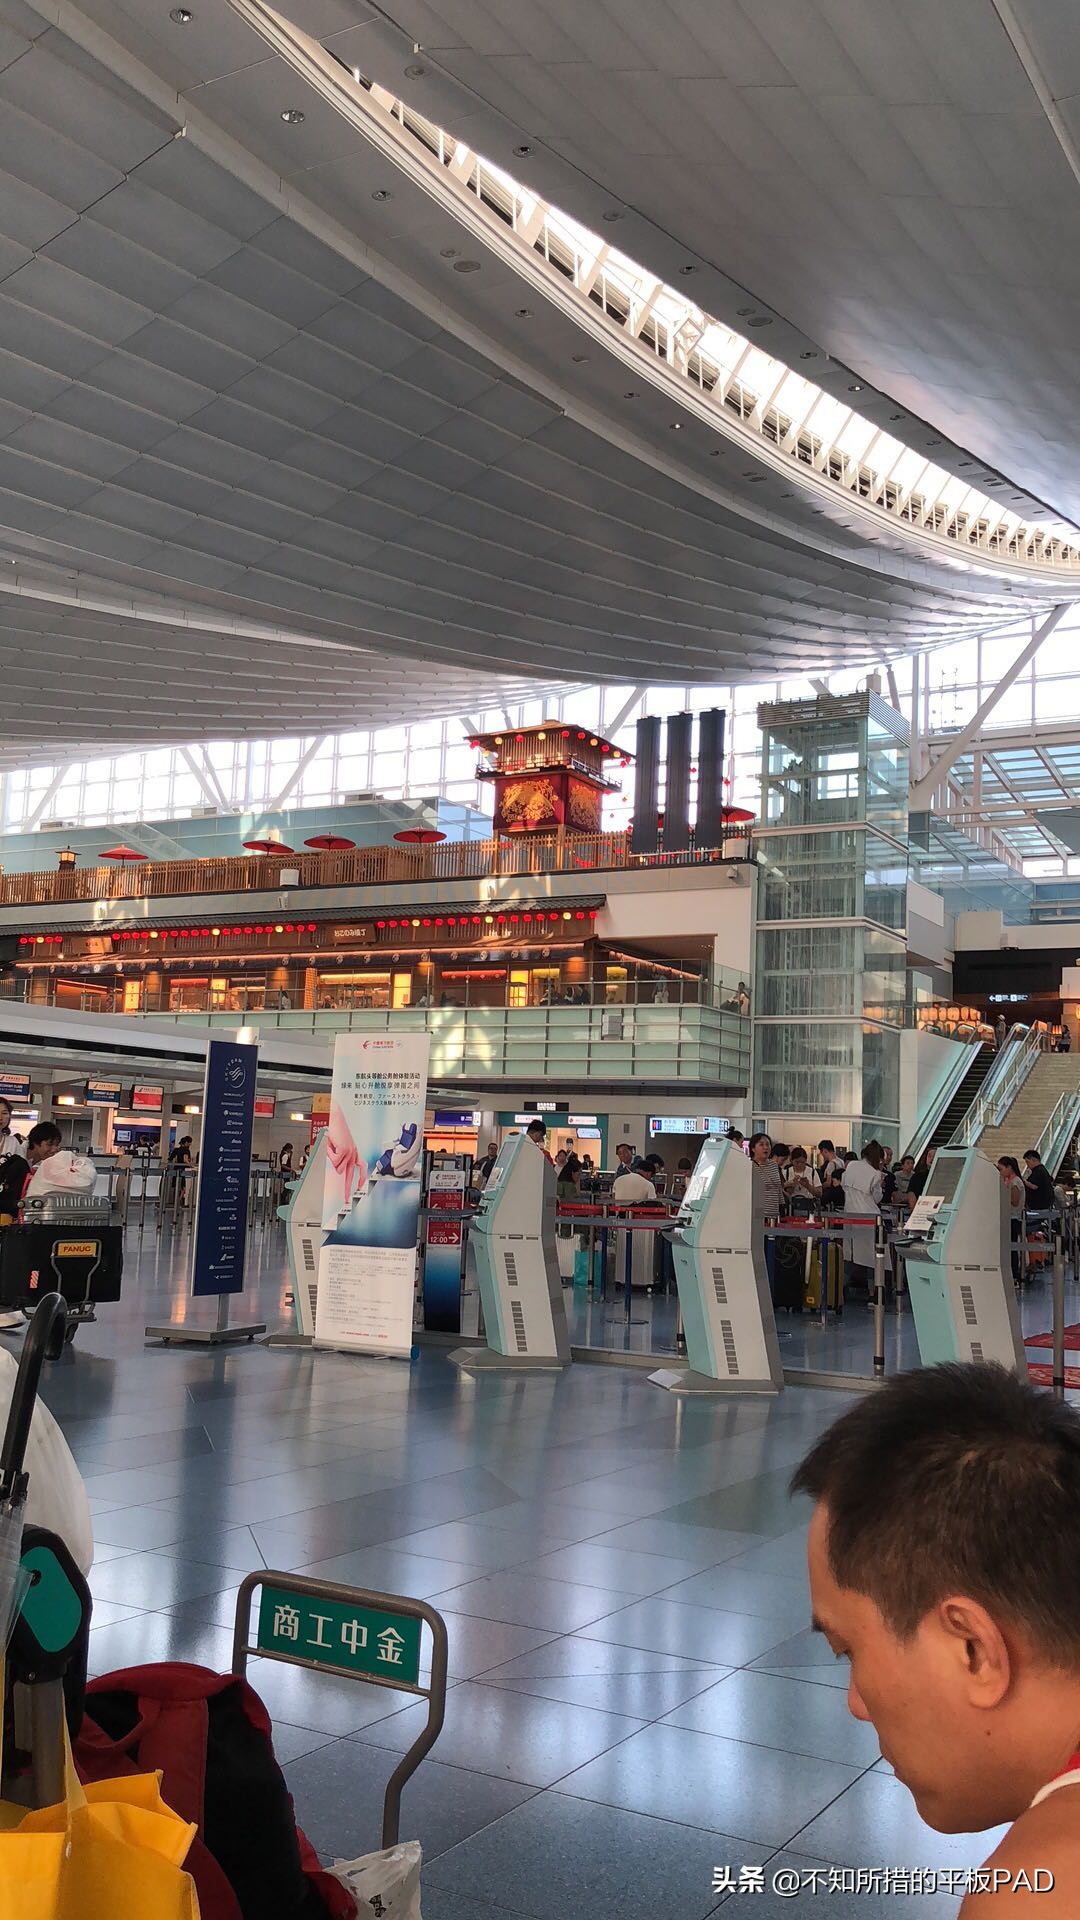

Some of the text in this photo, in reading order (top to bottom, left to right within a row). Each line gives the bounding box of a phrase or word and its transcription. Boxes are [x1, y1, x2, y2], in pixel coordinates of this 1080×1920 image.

[63, 1245, 91, 1253] FANUC
[273, 1604, 406, 1665] 商工中金
